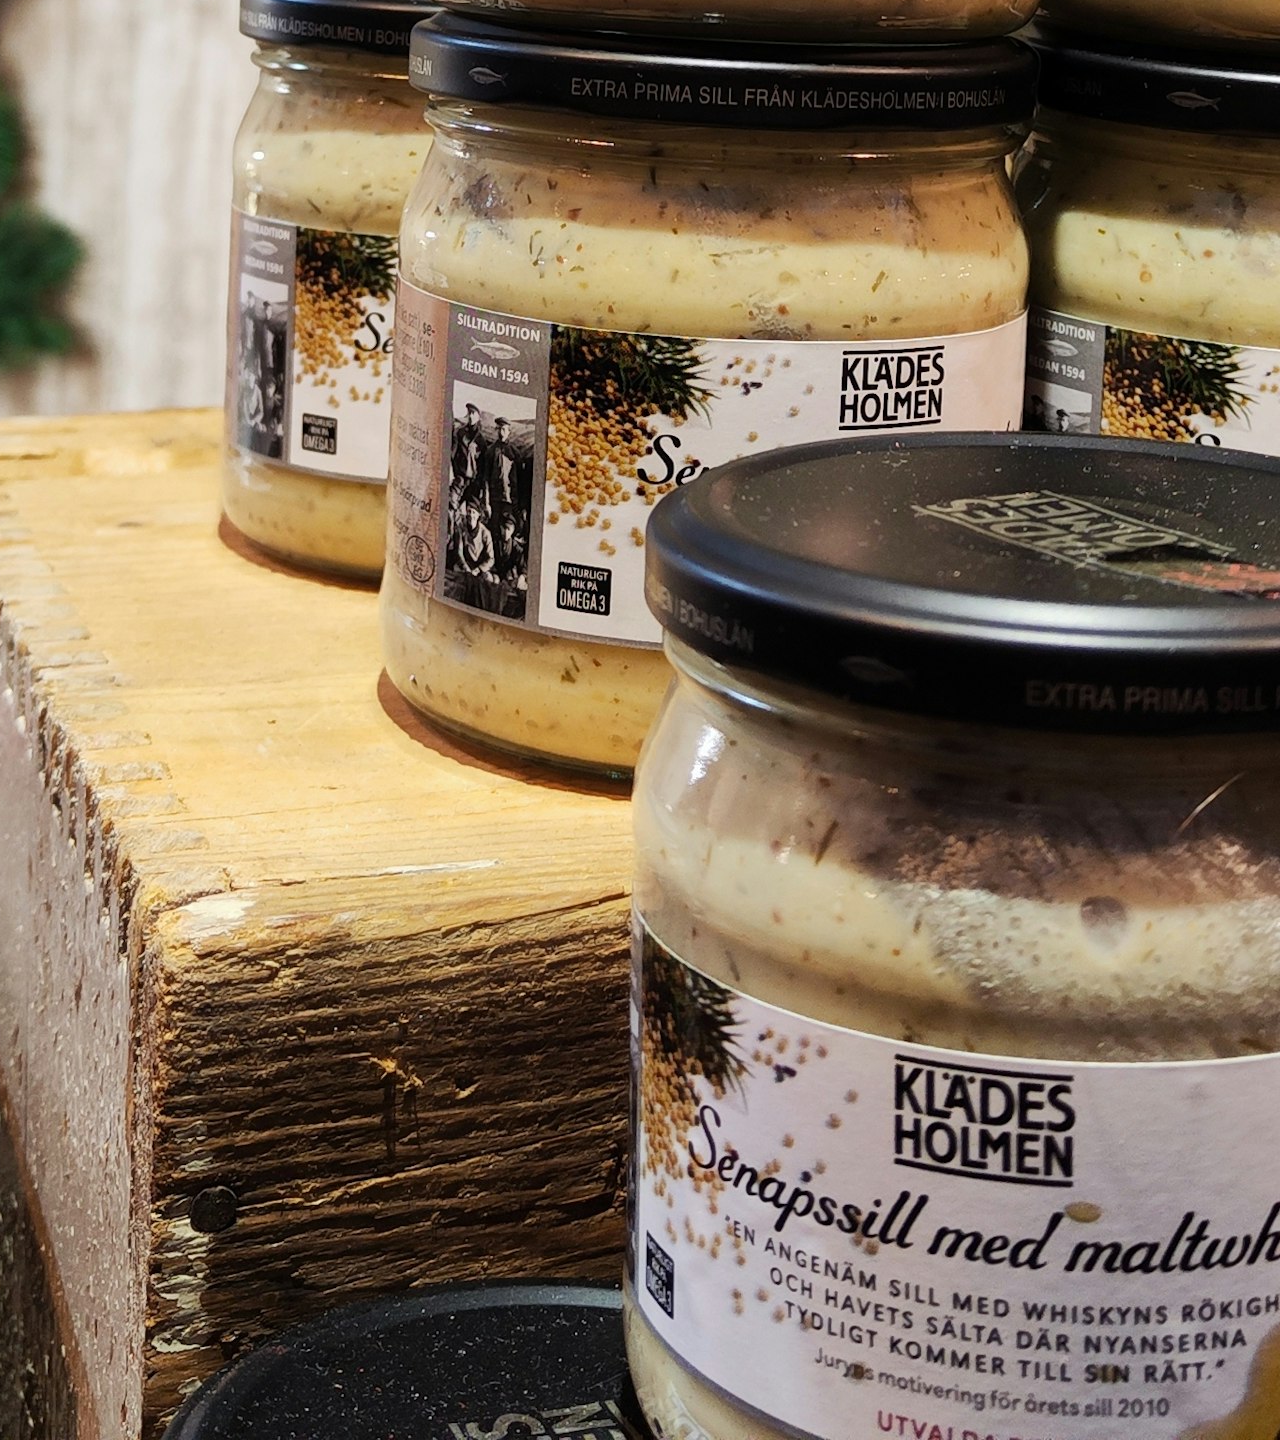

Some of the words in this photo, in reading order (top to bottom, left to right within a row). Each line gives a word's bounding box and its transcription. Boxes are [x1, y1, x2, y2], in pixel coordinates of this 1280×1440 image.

[572, 78, 627, 99] EXTRA
[635, 82, 692, 103] PRIMA
[699, 83, 737, 105] SILL
[742, 81, 796, 107] FRÅN
[802, 86, 935, 111] KLÄDESHOLMEN
[457, 313, 540, 342] SILLTRADITION
[462, 358, 498, 379] REDAN
[500, 367, 529, 385] 1594
[841, 353, 944, 392] KLÄDES
[839, 389, 942, 423] HOLMEN
[894, 1064, 1076, 1132] KLÄDES
[894, 1114, 1074, 1177] HOLMEN
[689, 1104, 929, 1249] Senapssill
[927, 1212, 1064, 1270] med
[765, 1239, 877, 1292] ANGENÄM
[889, 1280, 940, 1307] SILL
[953, 1294, 1009, 1319] MED
[1023, 1302, 1168, 1325] WHISKYNS
[770, 1267, 814, 1299] OCH
[825, 1292, 913, 1328] HAVETS
[926, 1314, 1003, 1347] SÄLTA
[1017, 1329, 1069, 1352] DÄR
[1083, 1329, 1247, 1354] NYANSERNA
[784, 1301, 878, 1348] TYDLIGT
[890, 1336, 1006, 1377] KOMMER
[1018, 1360, 1072, 1382] TILL
[1084, 1362, 1129, 1383] SIN
[878, 1371, 985, 1410] motivering
[990, 1390, 1021, 1412] för
[1025, 1395, 1079, 1417] årets
[1118, 1398, 1169, 1417] 2010
